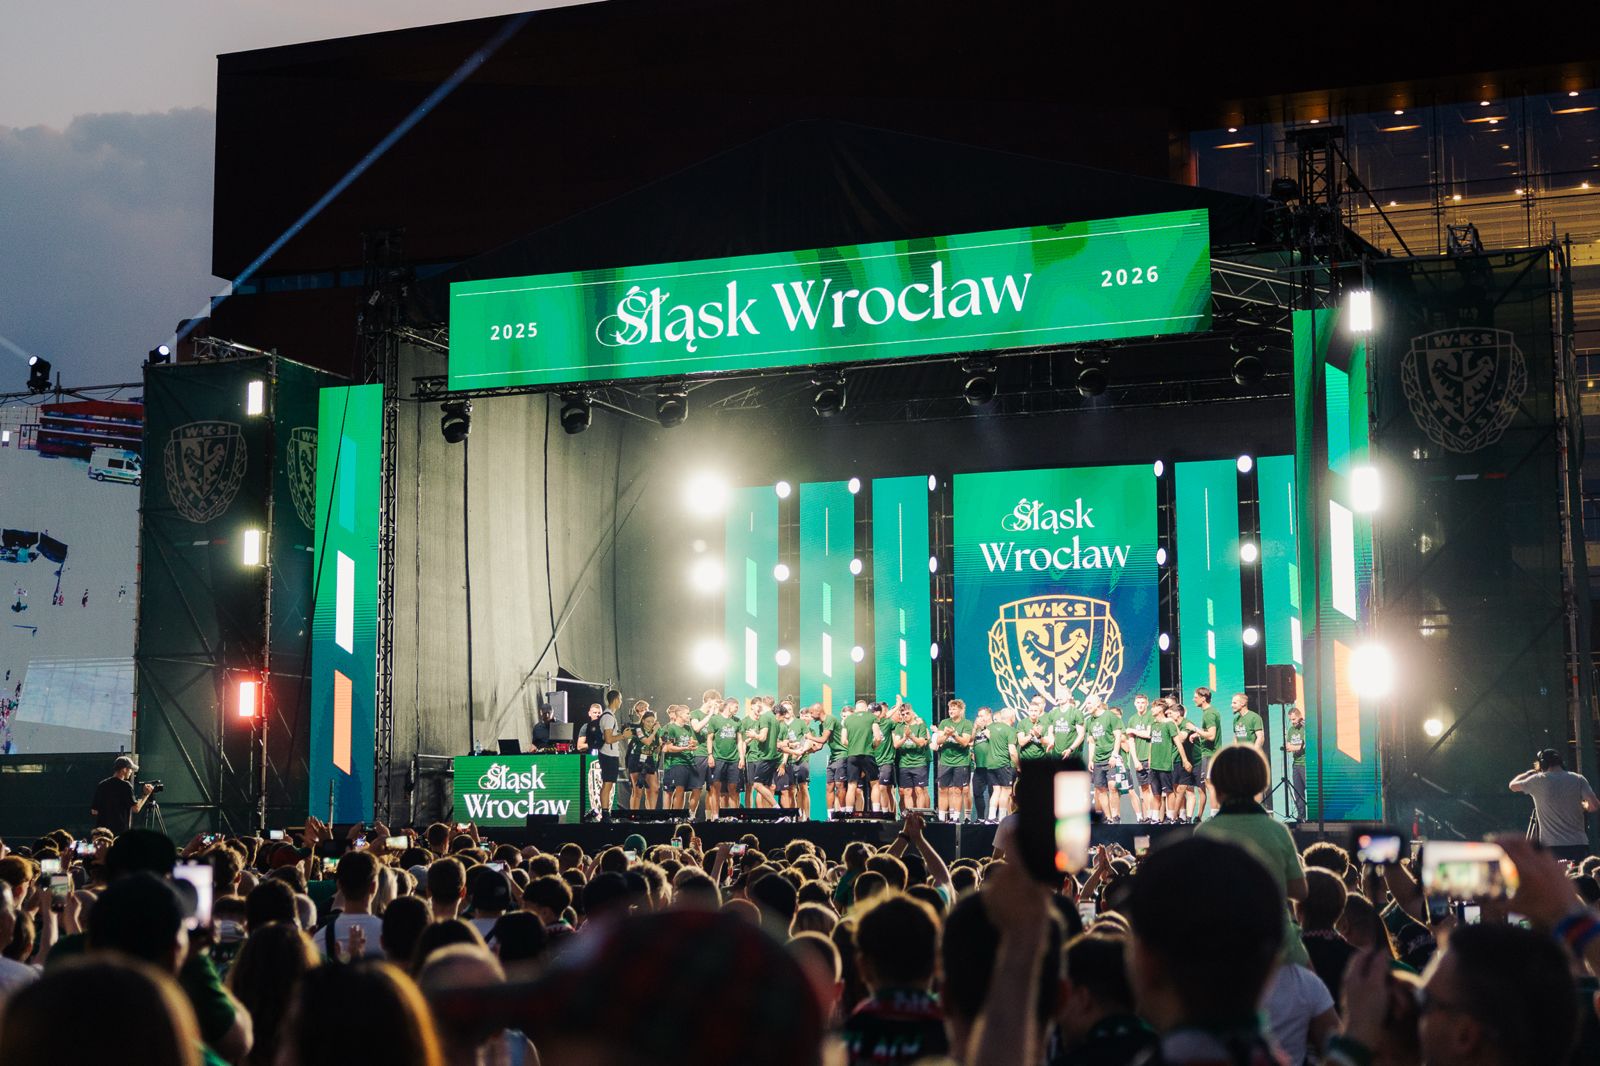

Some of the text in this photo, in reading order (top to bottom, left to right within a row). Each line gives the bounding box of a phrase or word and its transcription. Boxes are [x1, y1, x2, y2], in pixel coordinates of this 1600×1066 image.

[1101, 265, 1159, 287] 2026
[595, 260, 1032, 353] Śląsk Wrocław
[490, 322, 538, 341] 2025
[1001, 498, 1095, 534] Śląsk
[979, 535, 1131, 572] Wrocław
[478, 762, 546, 794] Śląsk
[463, 791, 571, 819] Wrocław
